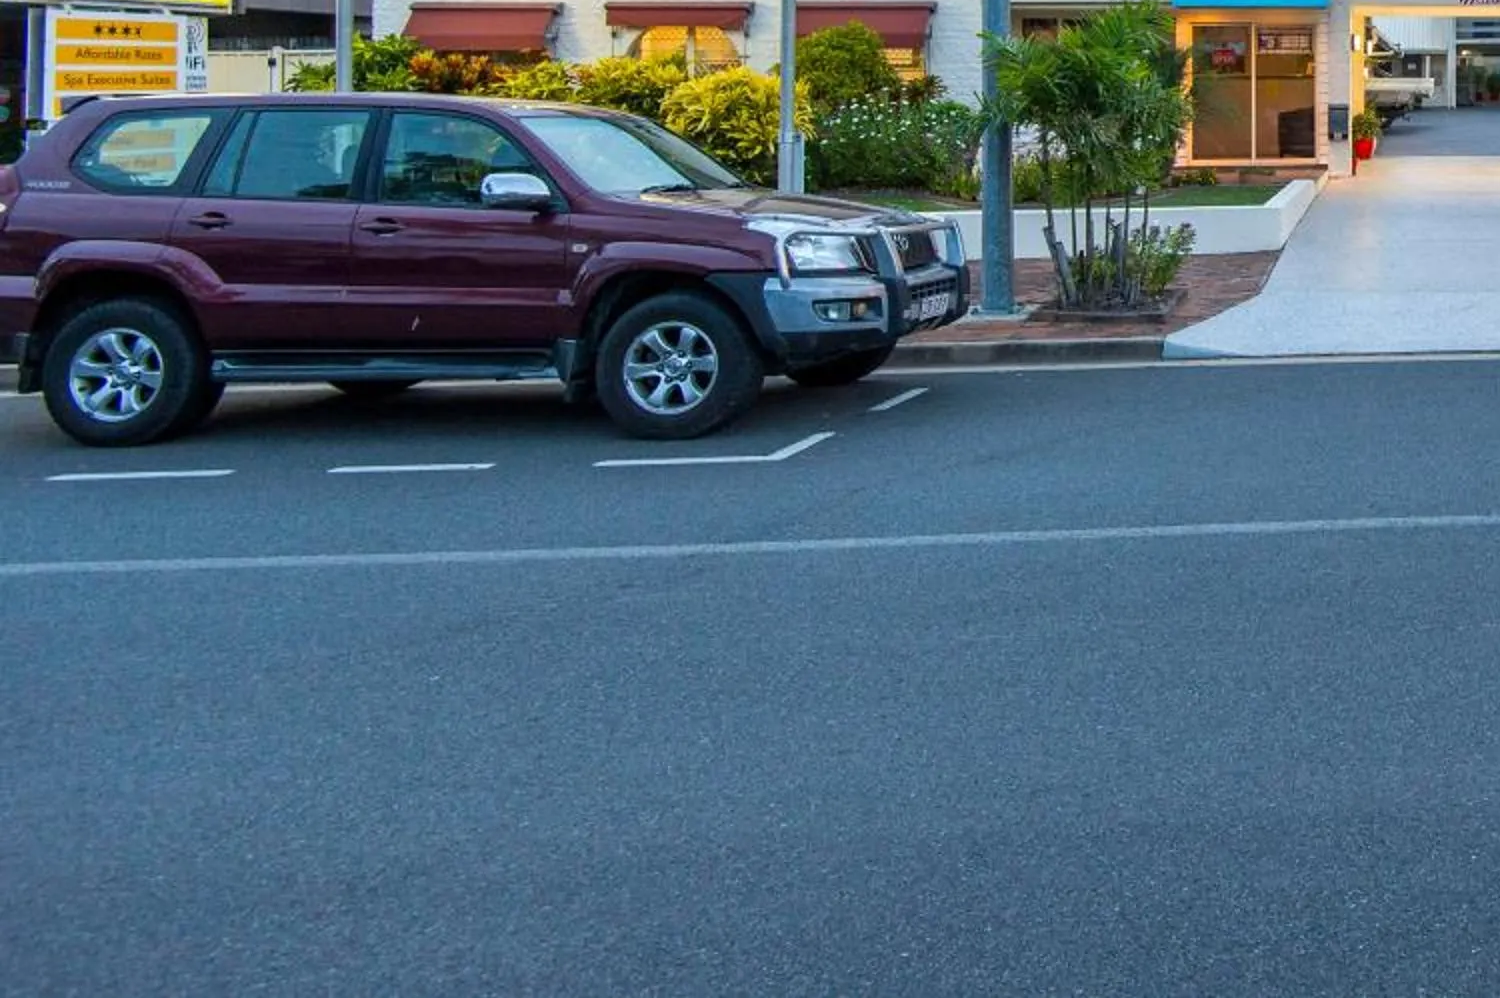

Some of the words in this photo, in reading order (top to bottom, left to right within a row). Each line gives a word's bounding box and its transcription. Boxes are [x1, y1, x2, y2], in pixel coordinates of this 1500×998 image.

[63, 74, 83, 88] Spa
[87, 74, 137, 85] Executive
[141, 74, 170, 85] Suites
